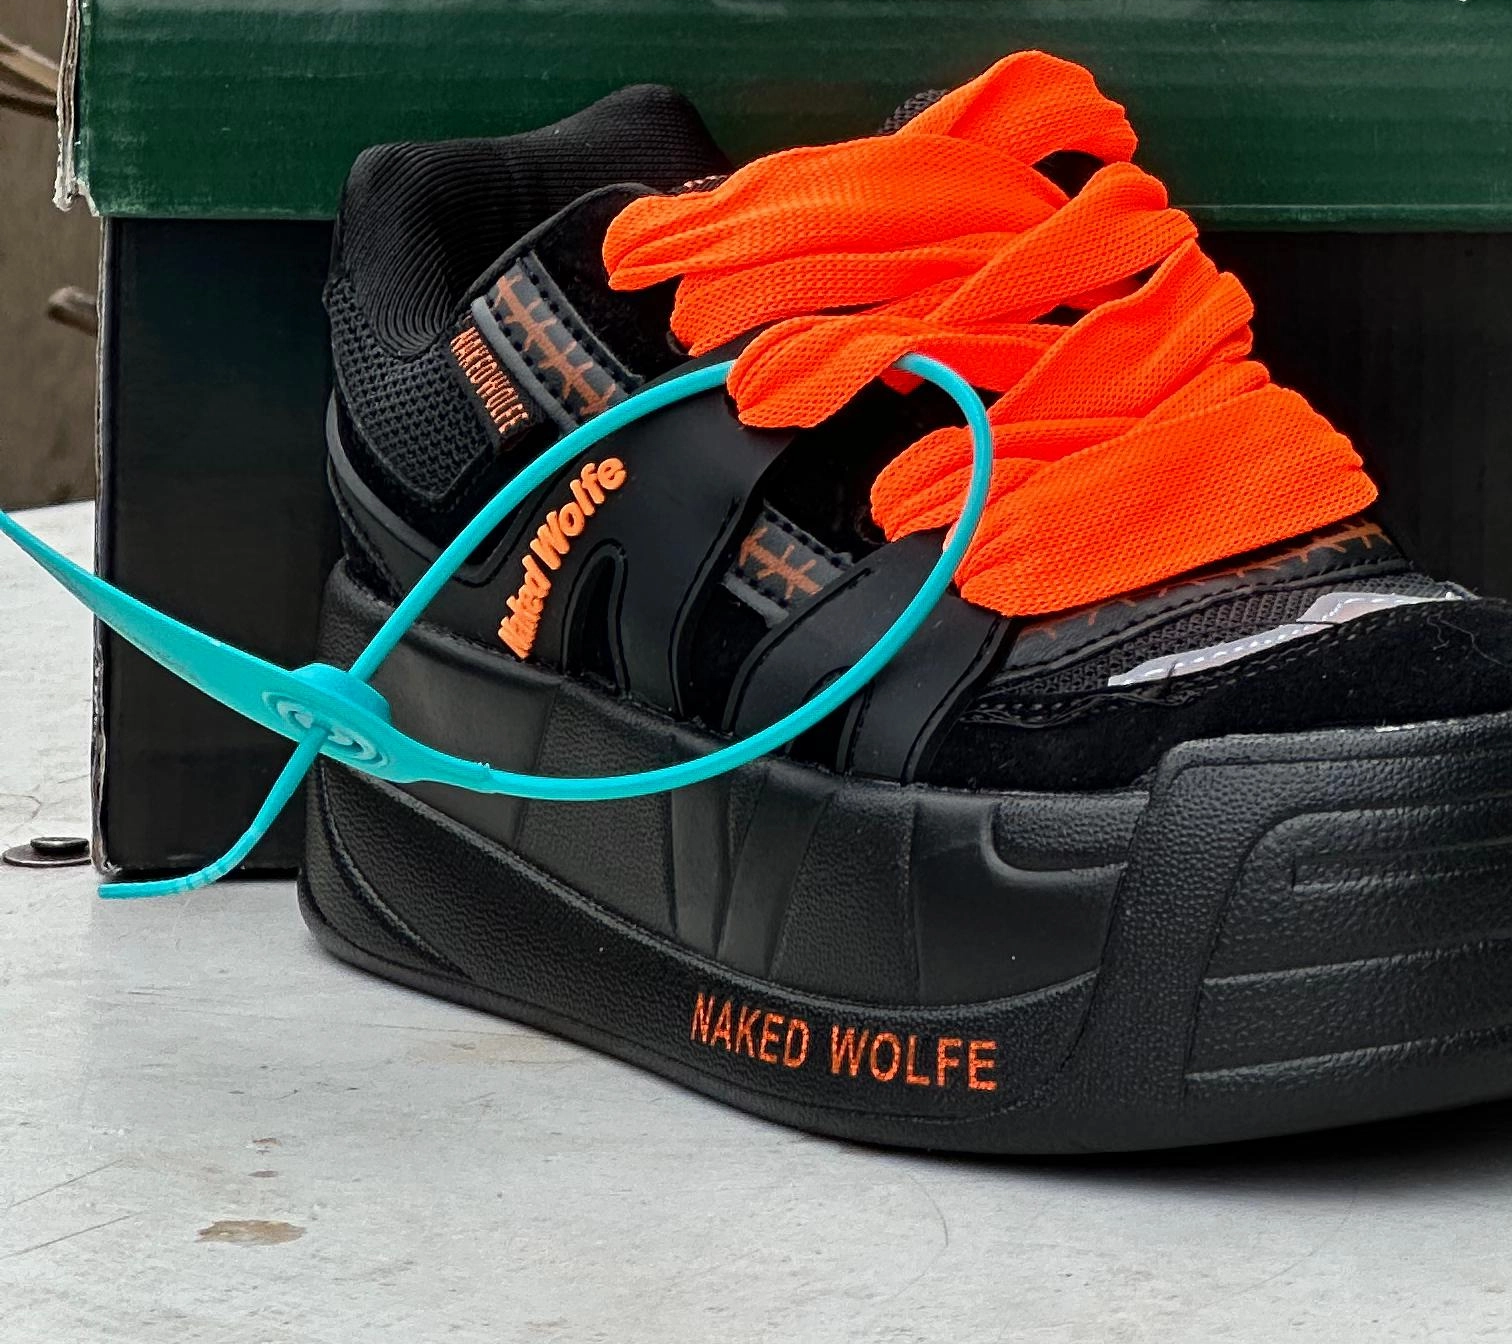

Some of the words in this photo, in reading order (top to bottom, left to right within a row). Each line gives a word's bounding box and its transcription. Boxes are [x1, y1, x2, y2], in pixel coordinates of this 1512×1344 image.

[530, 456, 628, 571] Wolfe
[690, 992, 811, 1069] NAKED
[830, 1024, 998, 1092] WOLFE
